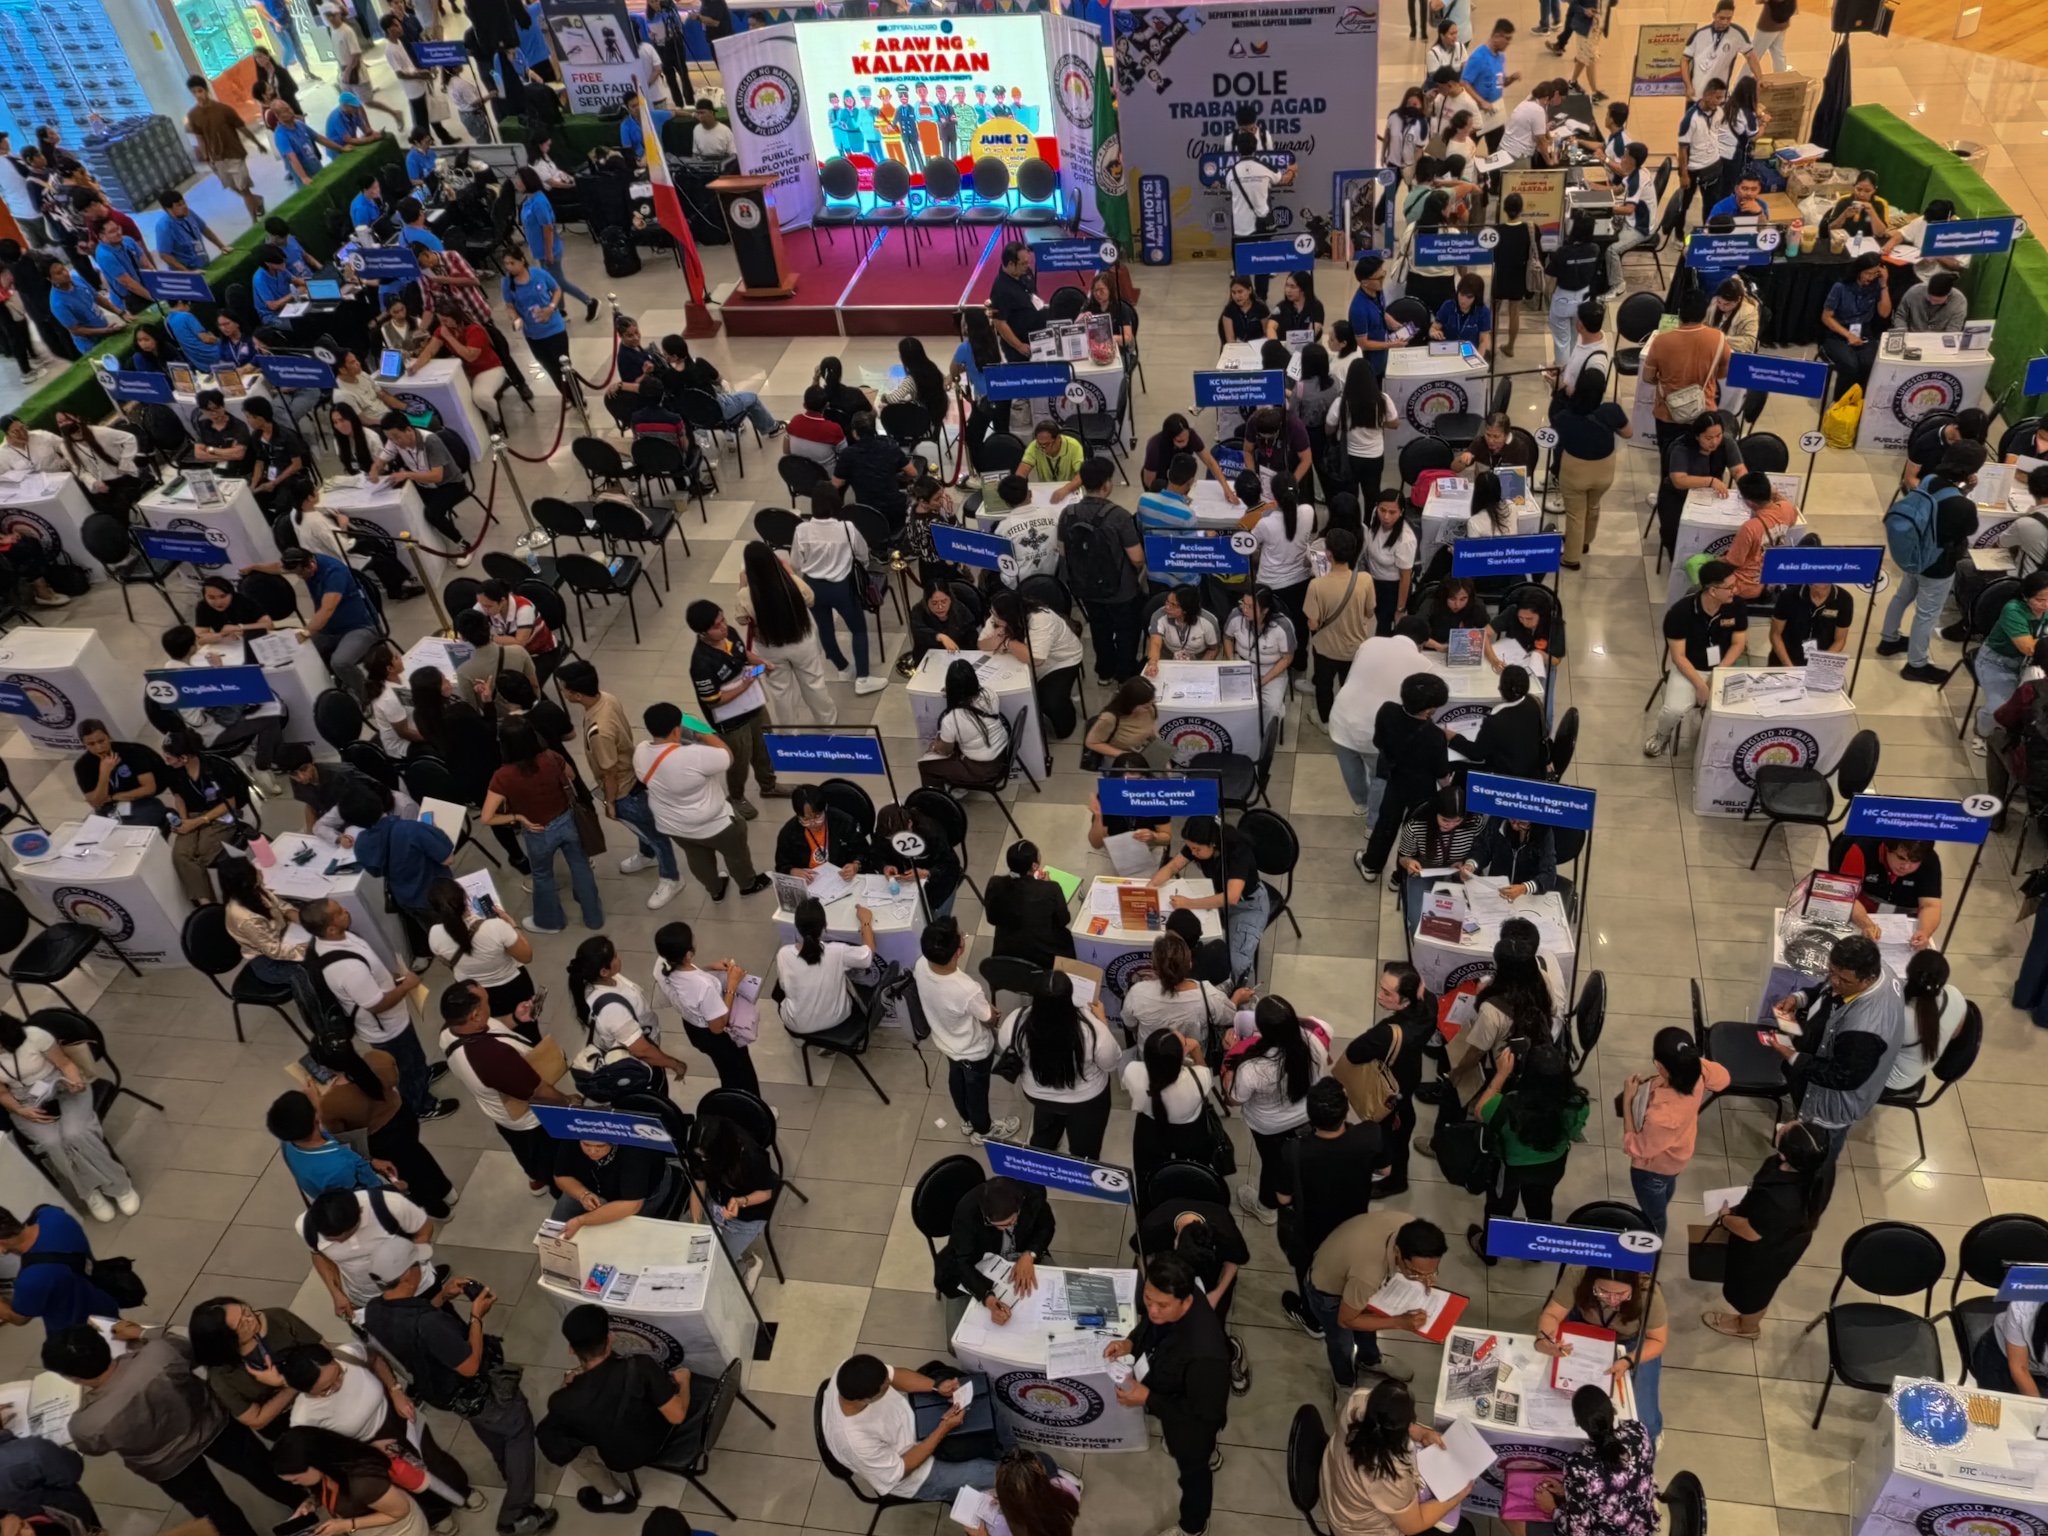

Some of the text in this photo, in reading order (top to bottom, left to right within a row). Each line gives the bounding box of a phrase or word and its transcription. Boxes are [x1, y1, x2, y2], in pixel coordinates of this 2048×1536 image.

[1208, 7, 1335, 19] DEPARTMENT LABOR AND EMPLOYMENT
[1232, 20, 1261, 28] NATIONAL
[1262, 19, 1287, 27] CAPITAL
[875, 36, 963, 52] ARAW NG
[852, 52, 989, 74] KALAYAAN
[572, 73, 604, 83] FREE
[1213, 70, 1288, 97] DOLE
[575, 83, 634, 95] JOB FAIR
[737, 71, 758, 108] LUNGSOD
[759, 67, 770, 75] NG
[1270, 98, 1327, 115] AGAD
[755, 117, 792, 136] PILIPINAS
[1201, 120, 1238, 137] JOB
[979, 133, 1029, 144] JUNE 12
[762, 148, 794, 163] PUBLIC
[748, 153, 811, 177] EMPLOYMENT
[1143, 180, 1155, 217] HOTS!
[1145, 221, 1156, 241] AM
[1297, 239, 1312, 248] 47
[1480, 233, 1497, 242] 46
[1760, 234, 1777, 244] 45
[1934, 240, 1982, 248] Management
[1102, 247, 1116, 257] 48
[1752, 373, 1786, 383] Solutions,
[1780, 369, 1806, 379] Service
[1221, 377, 1268, 385] Wonderland
[1896, 374, 1929, 399] LUNGSOD
[1067, 387, 1084, 397] 40
[1212, 394, 1239, 402] (World
[1408, 384, 1433, 410] LUNGSOD
[1537, 431, 1555, 443] 38
[1803, 436, 1822, 446] 37
[1008, 518, 1056, 536] STEELY RESOLVE
[207, 532, 226, 542] 33
[1233, 537, 1255, 548] 30
[967, 544, 984, 555] Food
[1170, 551, 1225, 560] Construction
[1505, 548, 1555, 556] Manpower
[1002, 559, 1015, 571] 31
[1165, 560, 1216, 568] Philippines,
[1487, 557, 1526, 565] Services
[1800, 563, 1842, 572] Brewery
[150, 686, 174, 697] 23
[221, 683, 240, 691] Inc.
[1204, 720, 1231, 747] MAYNILA
[1736, 731, 1775, 758] LUNGSOD
[1796, 733, 1817, 758] MAYNILA
[776, 749, 873, 761] Servicio Filipino, Inc.
[1121, 789, 1195, 800] Sports Central
[1472, 785, 1588, 811] Starworks Integrated
[1495, 798, 1564, 815] Services, Inc.
[1970, 798, 1994, 811] 19
[1862, 808, 1978, 823] HC Consumer Finance
[1875, 818, 1938, 829] Philippines,
[896, 836, 921, 852] 22
[1107, 952, 1140, 979] LUNGSOD
[1446, 962, 1485, 988] LUNGSOD
[566, 1124, 628, 1137] Specialists
[574, 1119, 631, 1131] Good Eats
[638, 1128, 662, 1136] 14
[1003, 1161, 1048, 1176] Services
[1005, 1155, 1054, 1172] Fieldmen
[1100, 1171, 1122, 1187] 13
[1535, 1235, 1606, 1250] Onesimus
[1627, 1235, 1654, 1248] 12
[1528, 1242, 1612, 1259] Corporation
[1060, 1378, 1101, 1411] MAYNILA
[1024, 1412, 1085, 1427] PILIPINAS
[1013, 1432, 1110, 1449] SERVICE OFFICE
[1038, 1431, 1125, 1444] EMPLOYMENT
[1529, 1446, 1548, 1454] NG
[1959, 1466, 1977, 1476] PTC
[1925, 1504, 2013, 1521] LUNGSOD NG
